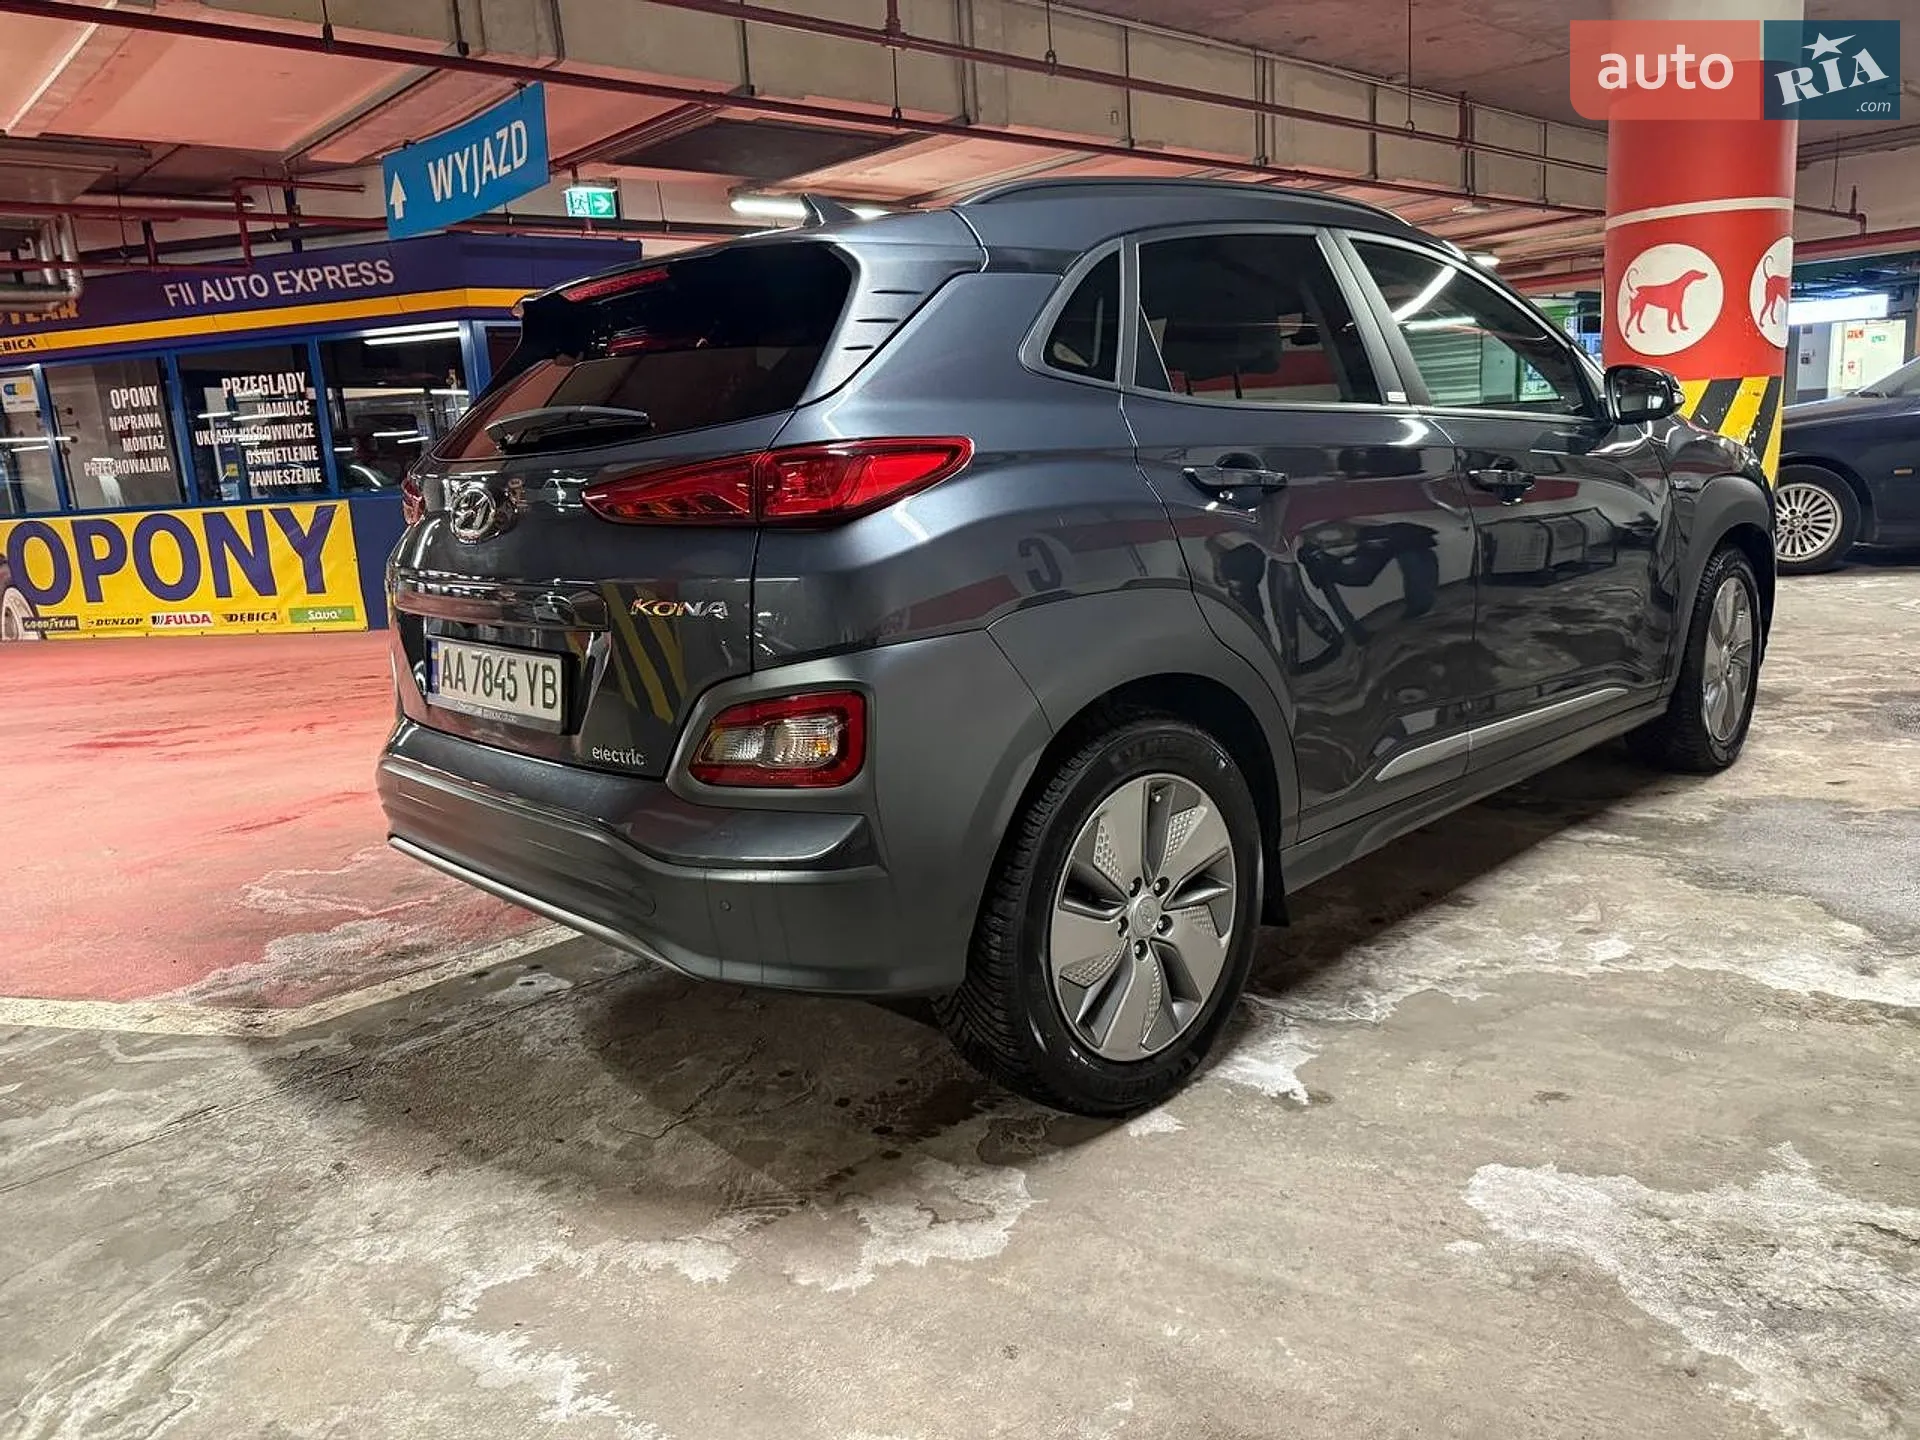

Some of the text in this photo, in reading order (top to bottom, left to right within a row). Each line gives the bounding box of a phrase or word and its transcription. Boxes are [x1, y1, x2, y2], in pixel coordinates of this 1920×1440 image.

[428, 119, 528, 203] WYJAZD
[164, 259, 395, 307] FII AUTO EXPRESS
[0, 337, 36, 351] BICA
[109, 385, 158, 410] OPONY
[109, 412, 162, 432] NAPRAWA
[122, 430, 166, 452] MONTAŻ
[247, 467, 323, 487] ZAWIESZENIE
[6, 504, 338, 606] OPONY
[95, 617, 143, 626] DUNLOP
[163, 613, 212, 625] FULDA
[630, 598, 728, 619] KONA
[441, 648, 557, 710] AA 7845 YB
[592, 744, 645, 767] electric
